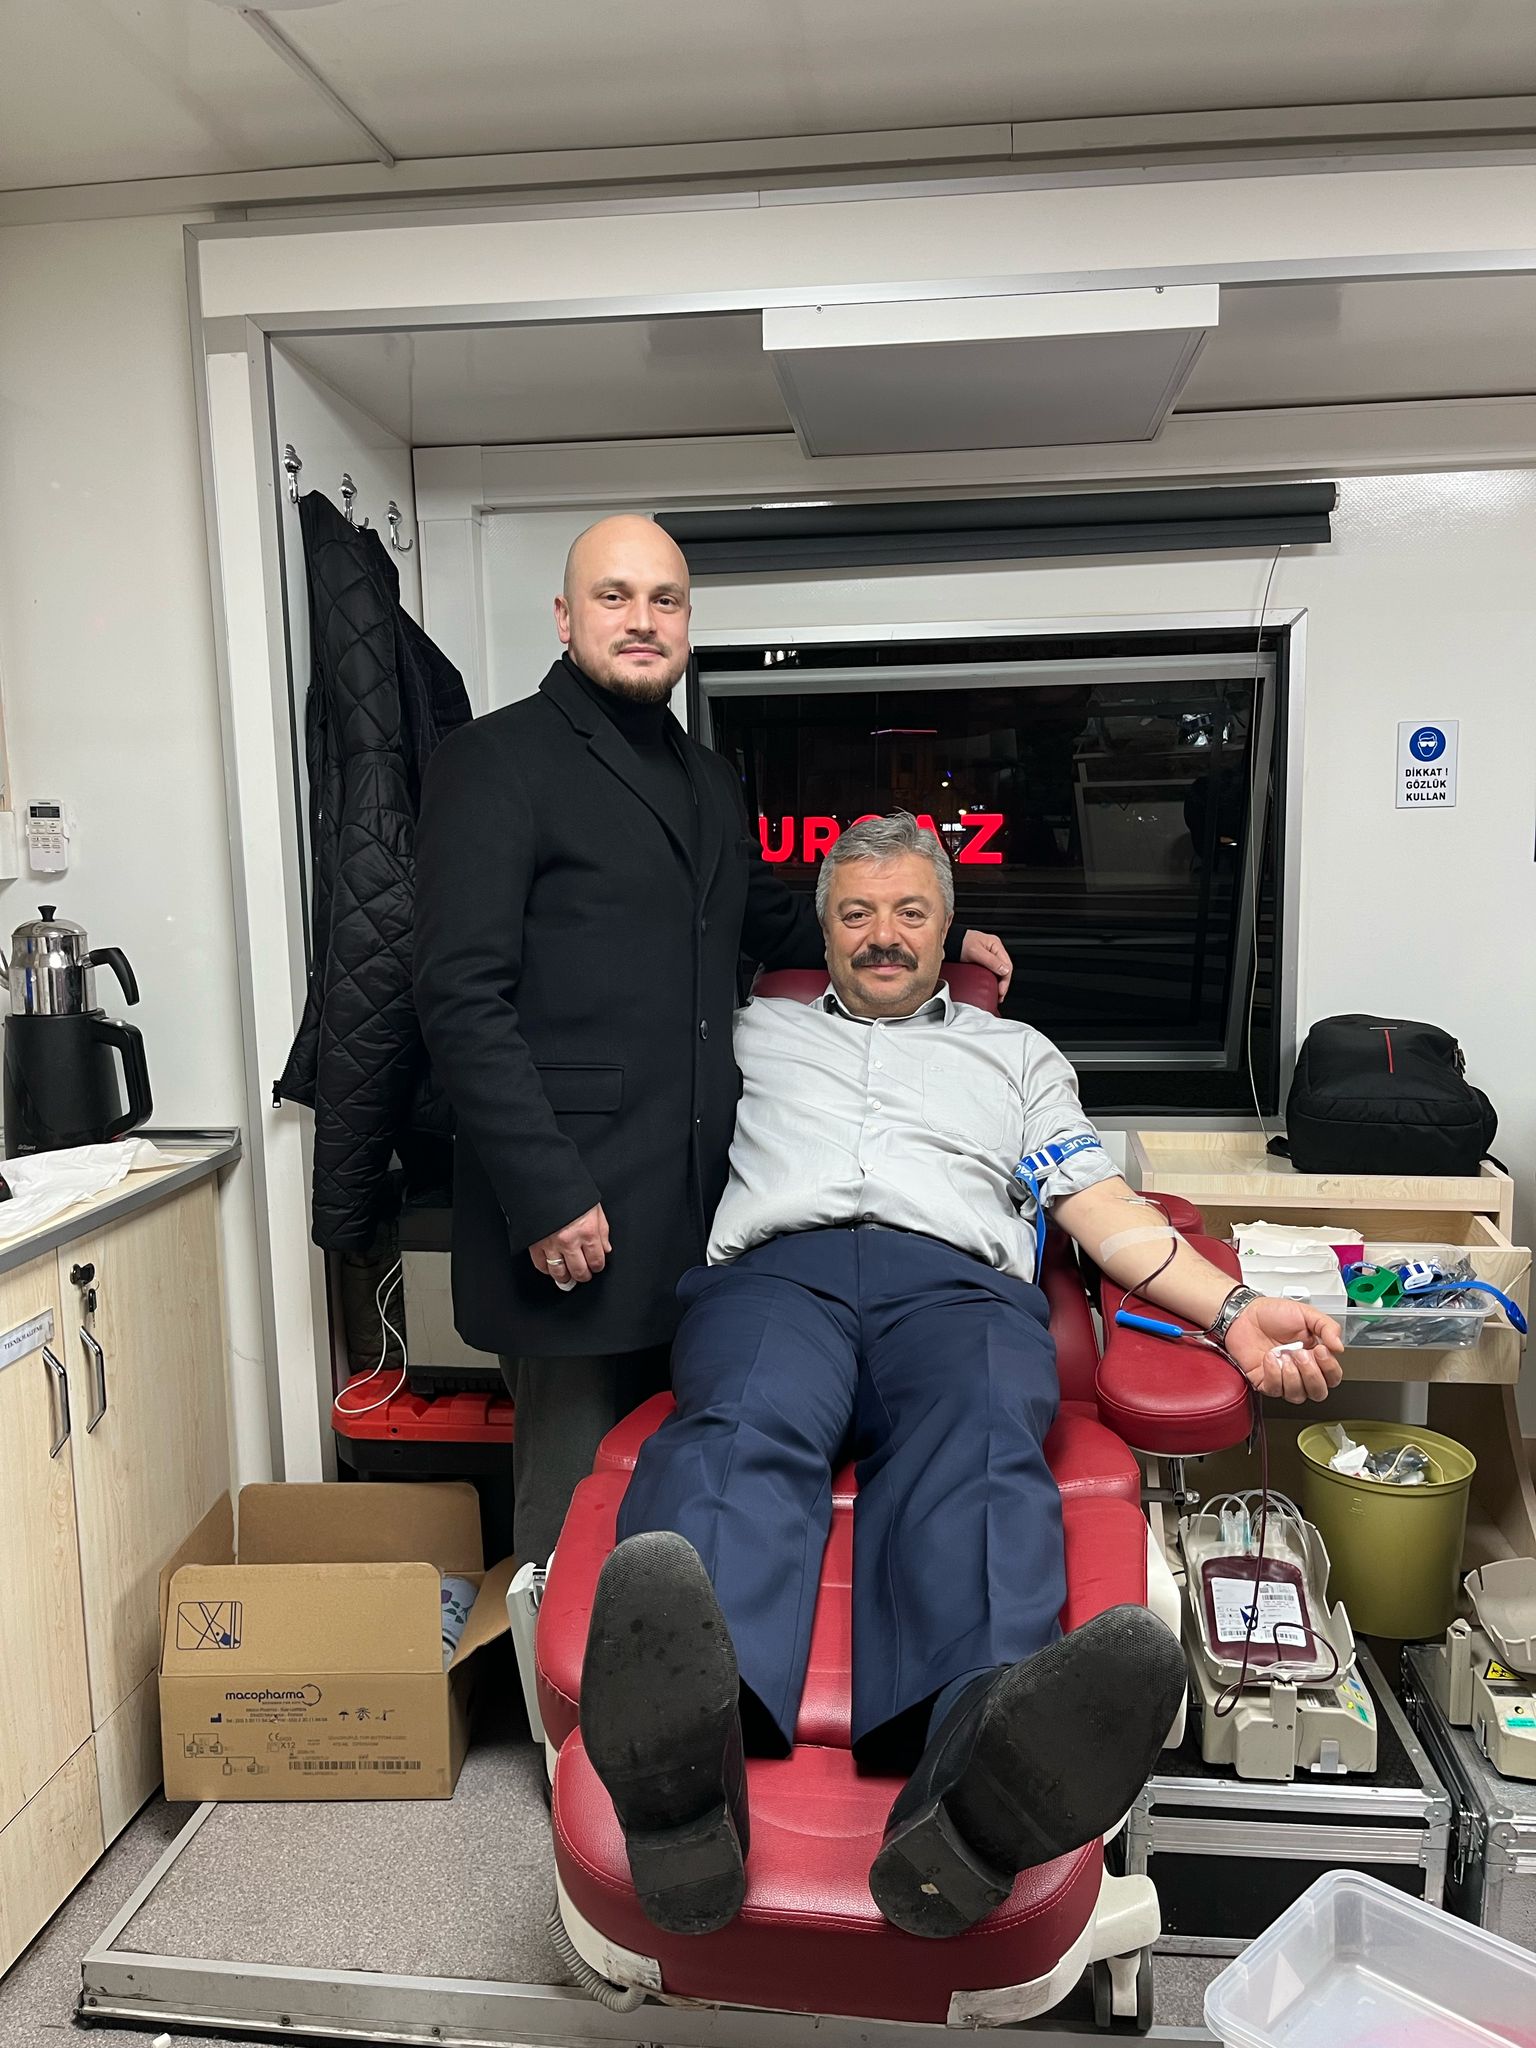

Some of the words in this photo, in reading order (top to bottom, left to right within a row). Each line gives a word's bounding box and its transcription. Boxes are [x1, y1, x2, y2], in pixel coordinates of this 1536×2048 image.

[1405, 767, 1443, 777] DİKKAT
[1406, 779, 1447, 789] GÖZLÜK
[1406, 792, 1446, 801] KULLAN
[225, 1689, 305, 1703] macopharma
